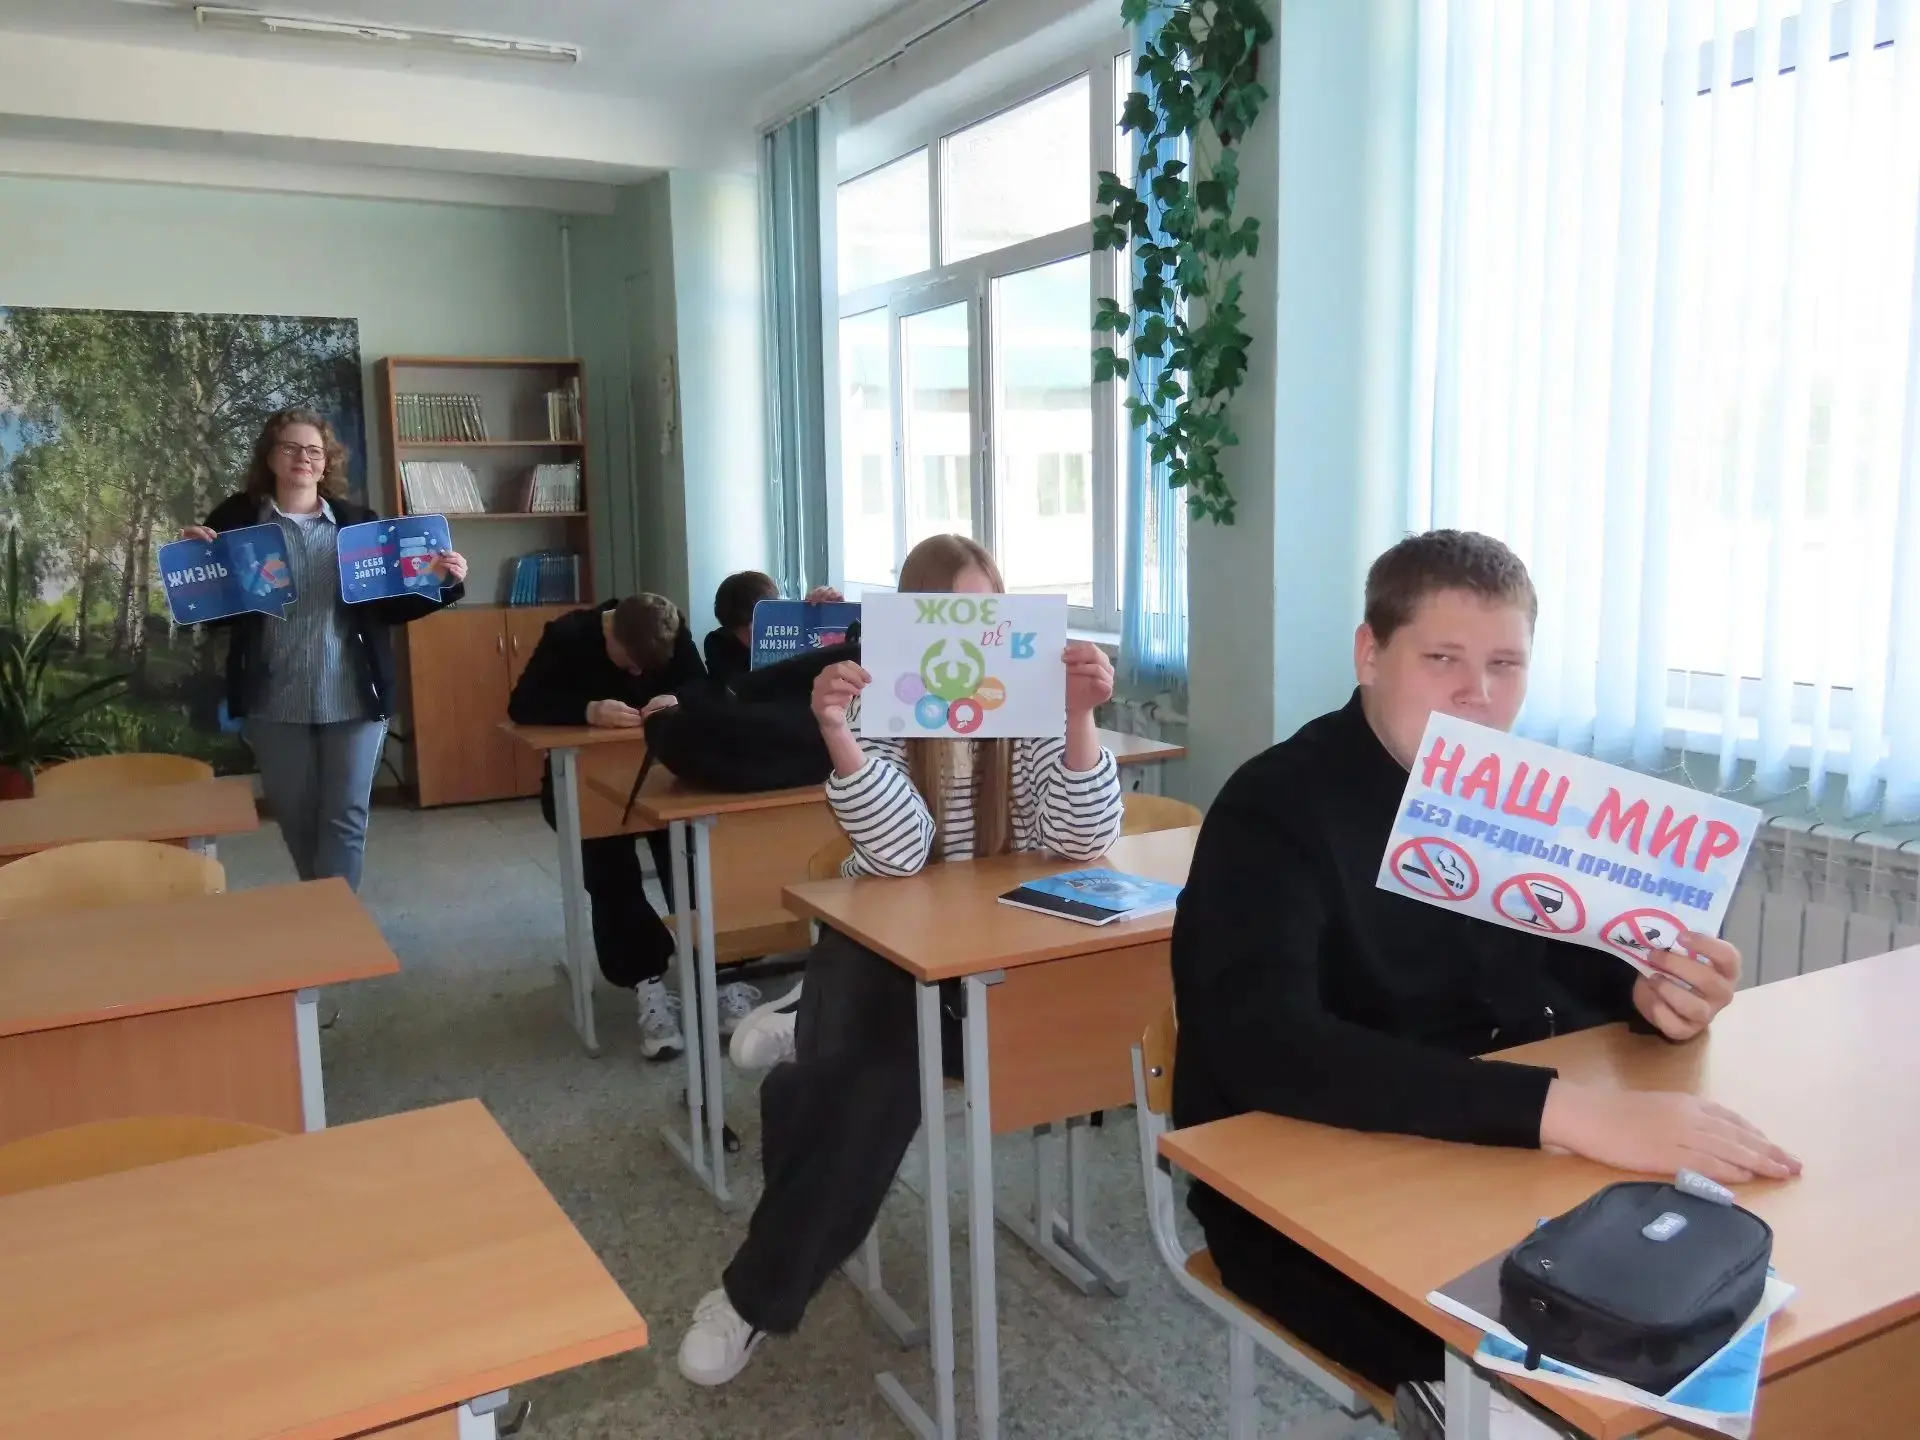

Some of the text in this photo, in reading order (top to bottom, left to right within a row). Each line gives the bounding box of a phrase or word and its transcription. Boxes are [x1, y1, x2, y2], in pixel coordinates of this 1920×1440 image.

[167, 562, 228, 588] ЖИЗНЬ
[354, 556, 384, 570] У СЕБЯ
[354, 567, 387, 580] ЗАВТРА
[914, 598, 999, 625] ЗОЖ
[765, 625, 800, 637] ДЕВИЗ
[980, 620, 1038, 659] Я за
[759, 639, 796, 650] ЖИЗНИ
[1421, 736, 1740, 873] НАШ МИР
[1405, 798, 1715, 912] БЕЗ ВРЕДНЫХ ПРИВЫЧЕК
